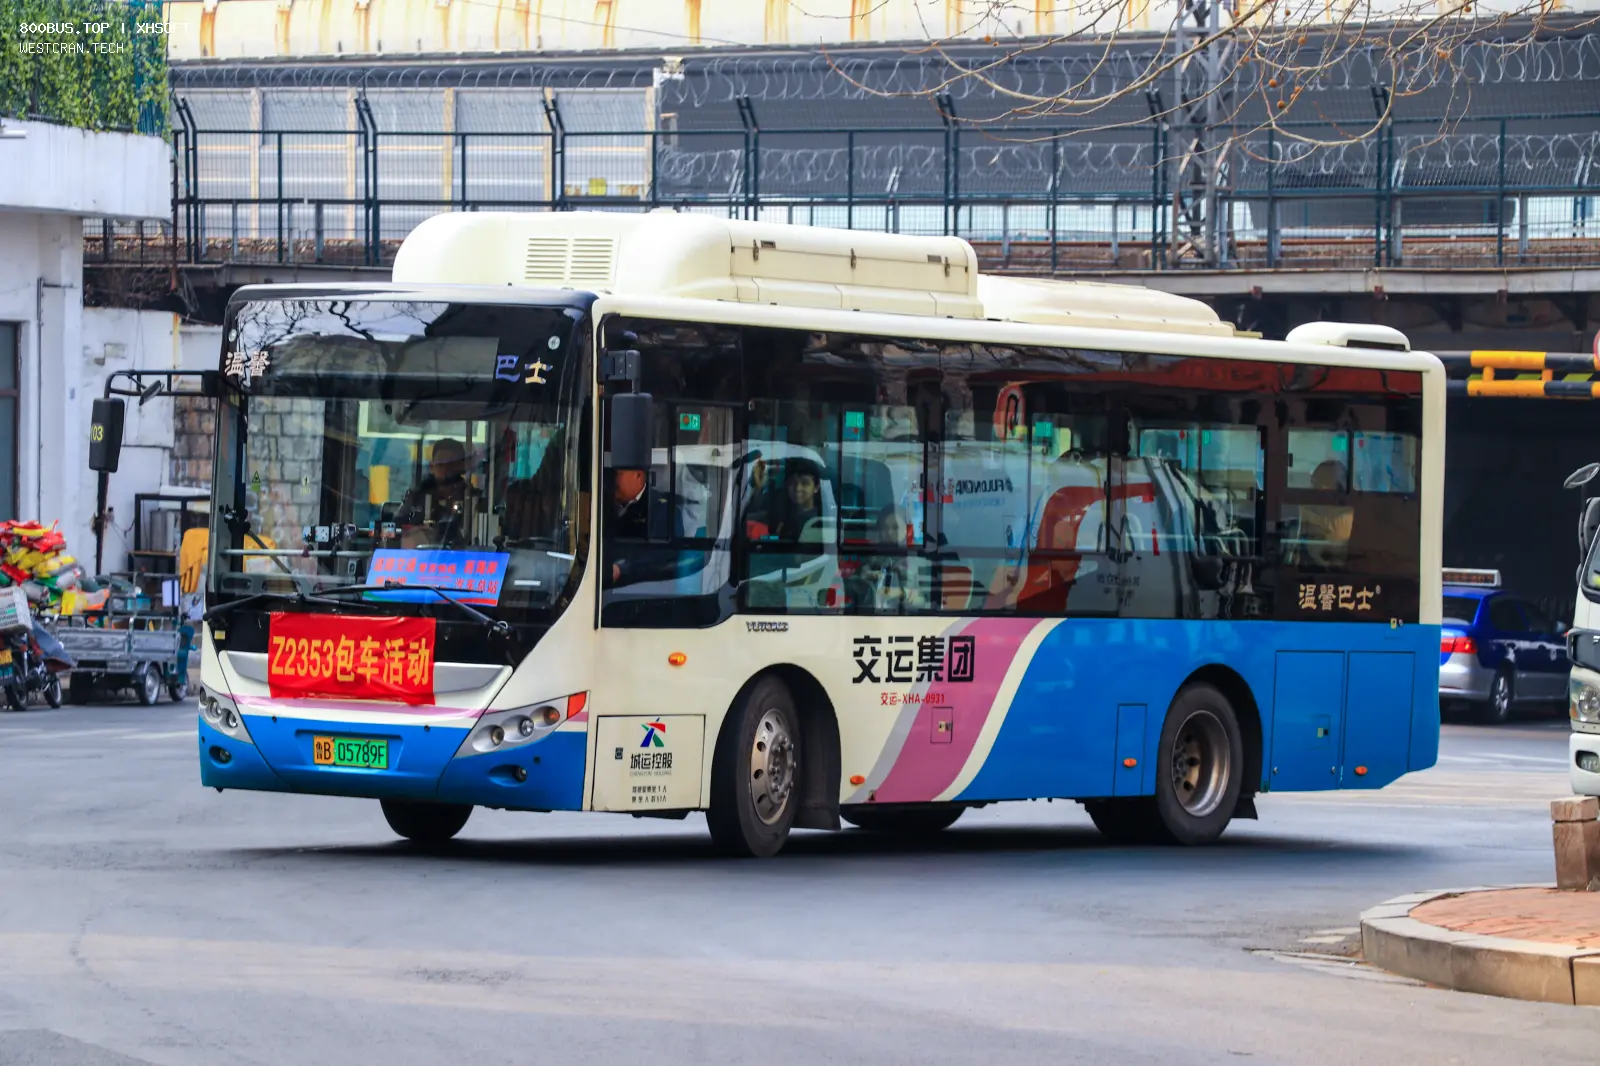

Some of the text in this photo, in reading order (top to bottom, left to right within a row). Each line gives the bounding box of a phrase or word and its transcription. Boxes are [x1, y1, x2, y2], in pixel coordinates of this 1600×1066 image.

[224, 351, 270, 377] 温馨
[495, 355, 554, 384] 巴士
[1298, 583, 1375, 611] 温馨巴士
[271, 634, 431, 687] Z2353包车活动
[852, 635, 976, 684] 交运集团
[880, 692, 945, 706] 交运-XHA-0931
[630, 752, 673, 770] 城运控股
